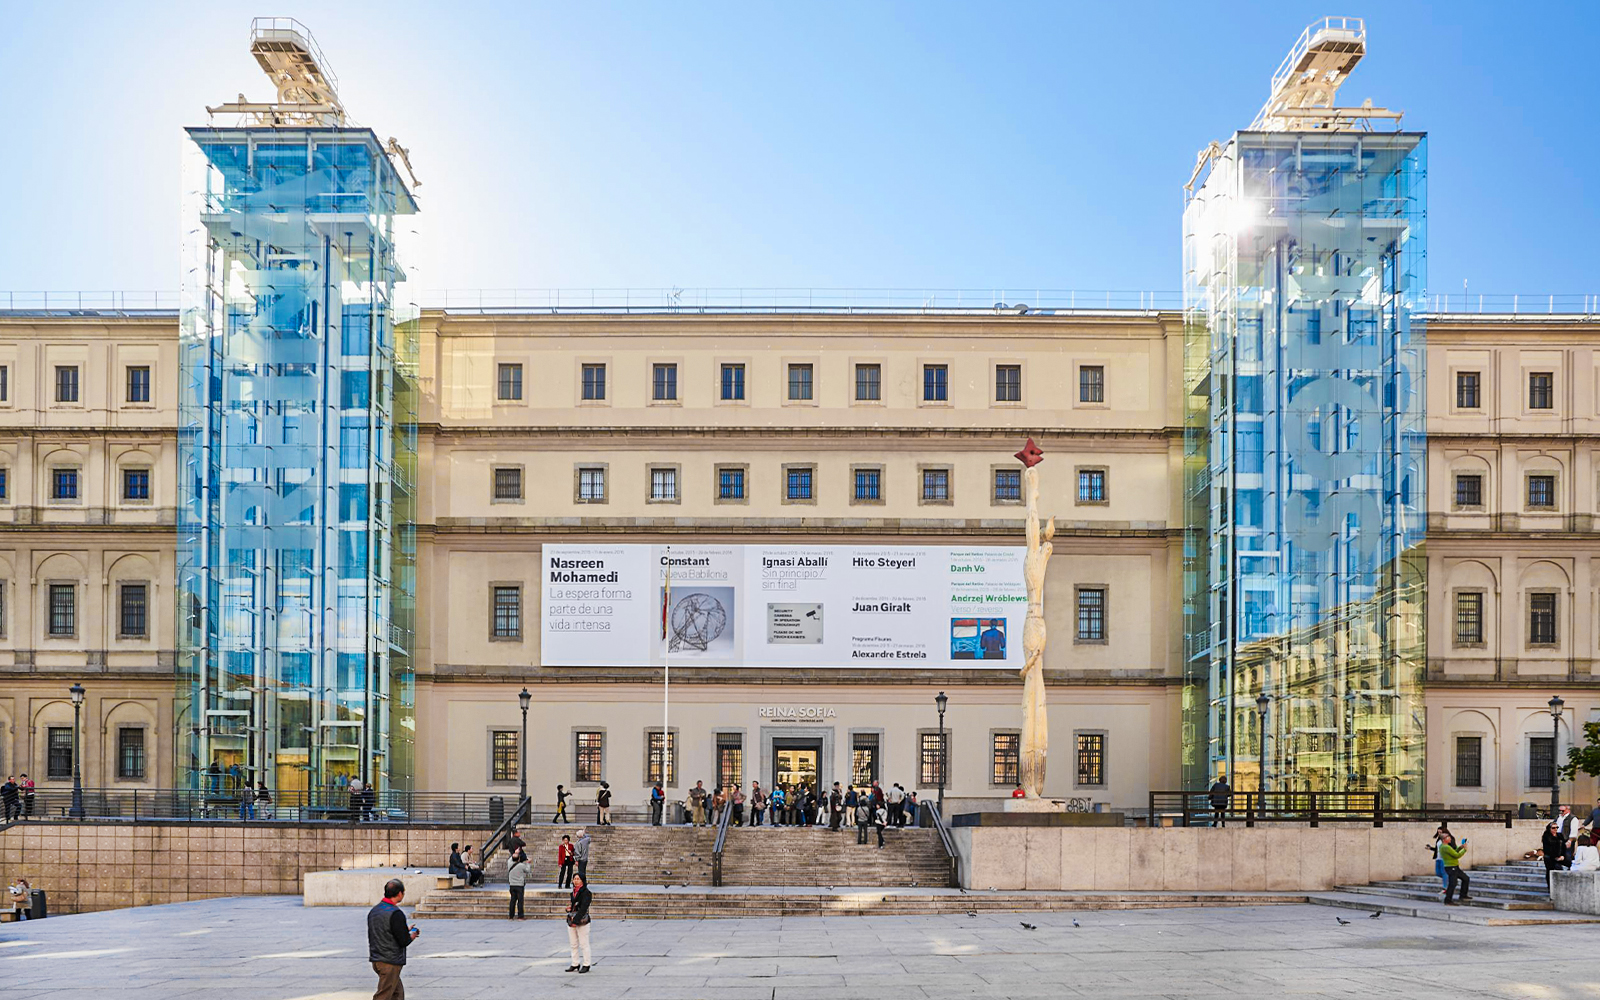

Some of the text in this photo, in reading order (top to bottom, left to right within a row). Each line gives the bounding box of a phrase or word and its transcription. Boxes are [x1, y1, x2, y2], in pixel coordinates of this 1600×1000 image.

[550, 558, 604, 568] Nasreen
[660, 556, 710, 566] Constant
[762, 557, 828, 568] Ignasi Aballí
[852, 557, 915, 569] Hito Steyerl
[550, 571, 618, 582] Mohamedi
[689, 570, 728, 579] Babilonia
[762, 568, 777, 577] Sin
[762, 578, 796, 589] sin final
[550, 587, 632, 600] La espera forma
[550, 603, 613, 616] parte de una
[852, 603, 911, 612] Juan Giralt
[549, 618, 611, 630] vida intensa
[759, 707, 796, 717] REINA
